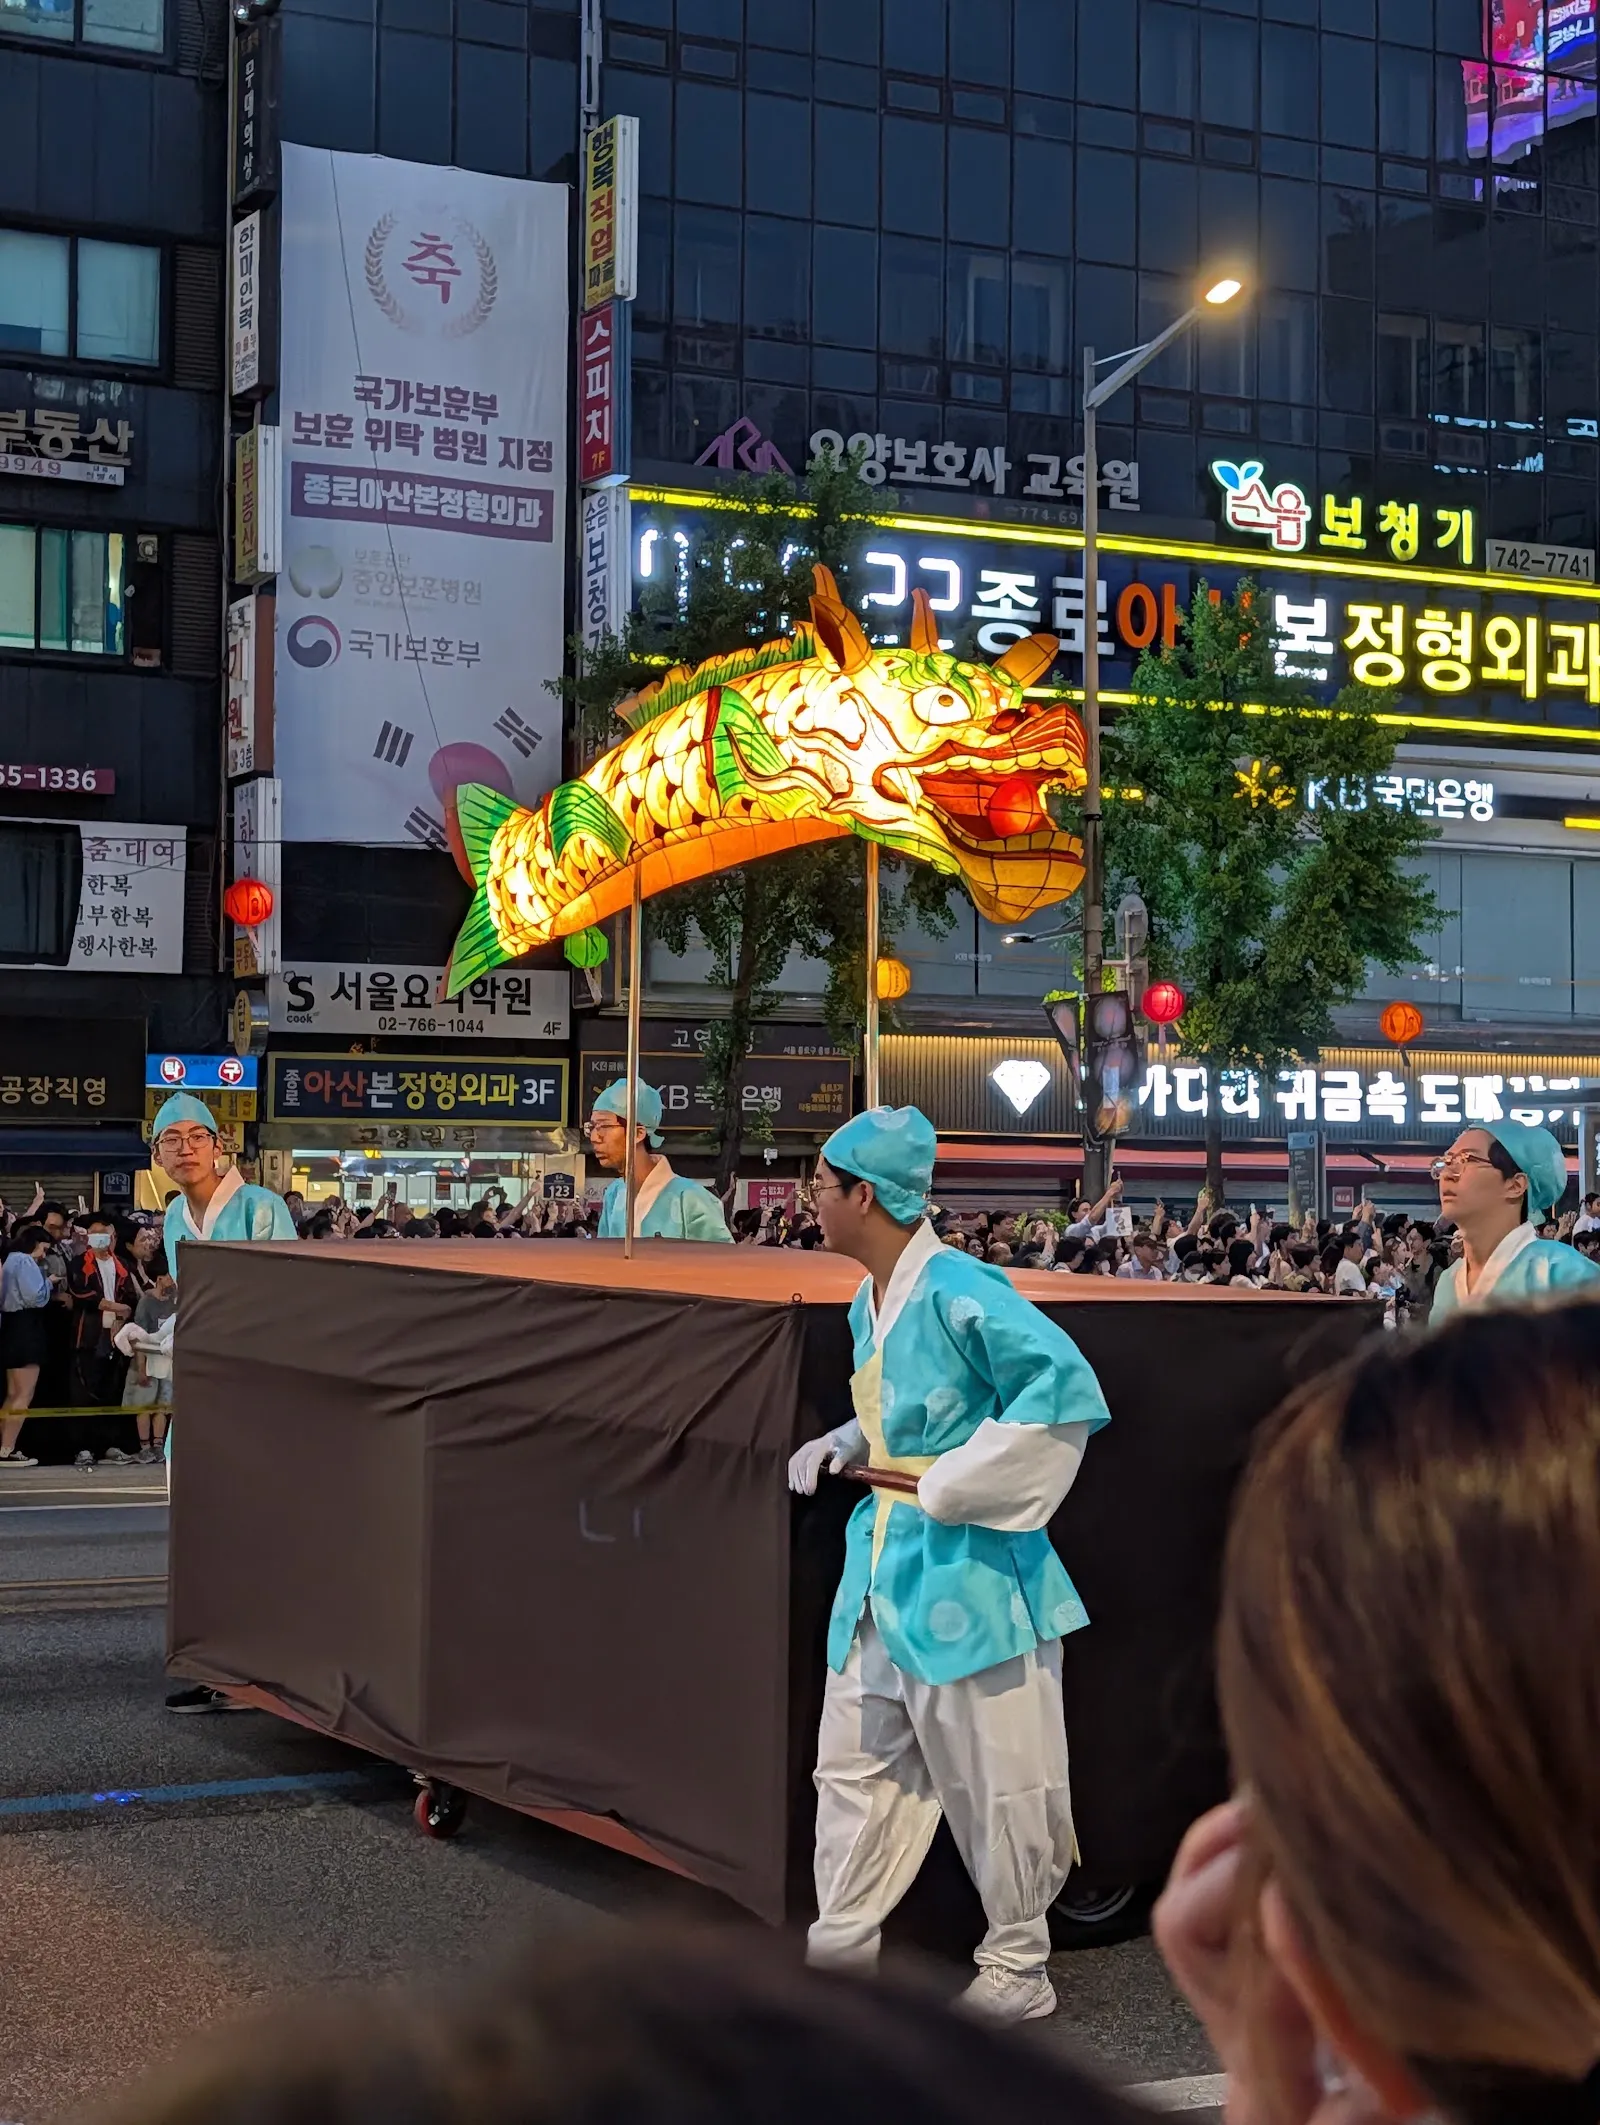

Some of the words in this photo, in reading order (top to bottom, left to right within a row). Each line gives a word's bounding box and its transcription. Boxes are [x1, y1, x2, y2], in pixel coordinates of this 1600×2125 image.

[239, 223, 255, 330] 한미인력
[402, 232, 462, 304] 축
[353, 375, 499, 425] 국가보훈부
[585, 320, 610, 445] 스피치
[292, 411, 354, 449] 보훈
[364, 418, 424, 456] 위탁
[433, 426, 488, 466] 병원
[498, 436, 553, 473] 지정
[806, 428, 1012, 494] 요양보호사
[1023, 453, 1141, 511] 교육원
[303, 473, 543, 528] 종로아산본정형외과
[1319, 493, 1474, 565] 보청기
[1495, 546, 1591, 577] 742-7741
[348, 629, 482, 668] 국가보훈부
[87, 874, 132, 896] 한복
[77, 934, 157, 958] 행사한복
[286, 1013, 313, 1024] cook
[378, 1016, 484, 1034] 02-766-1044
[542, 1021, 562, 1036] 4F
[303, 1069, 519, 1111] 아산본정형외과
[522, 1078, 555, 1105] 3F
[549, 1185, 570, 1199] 123
